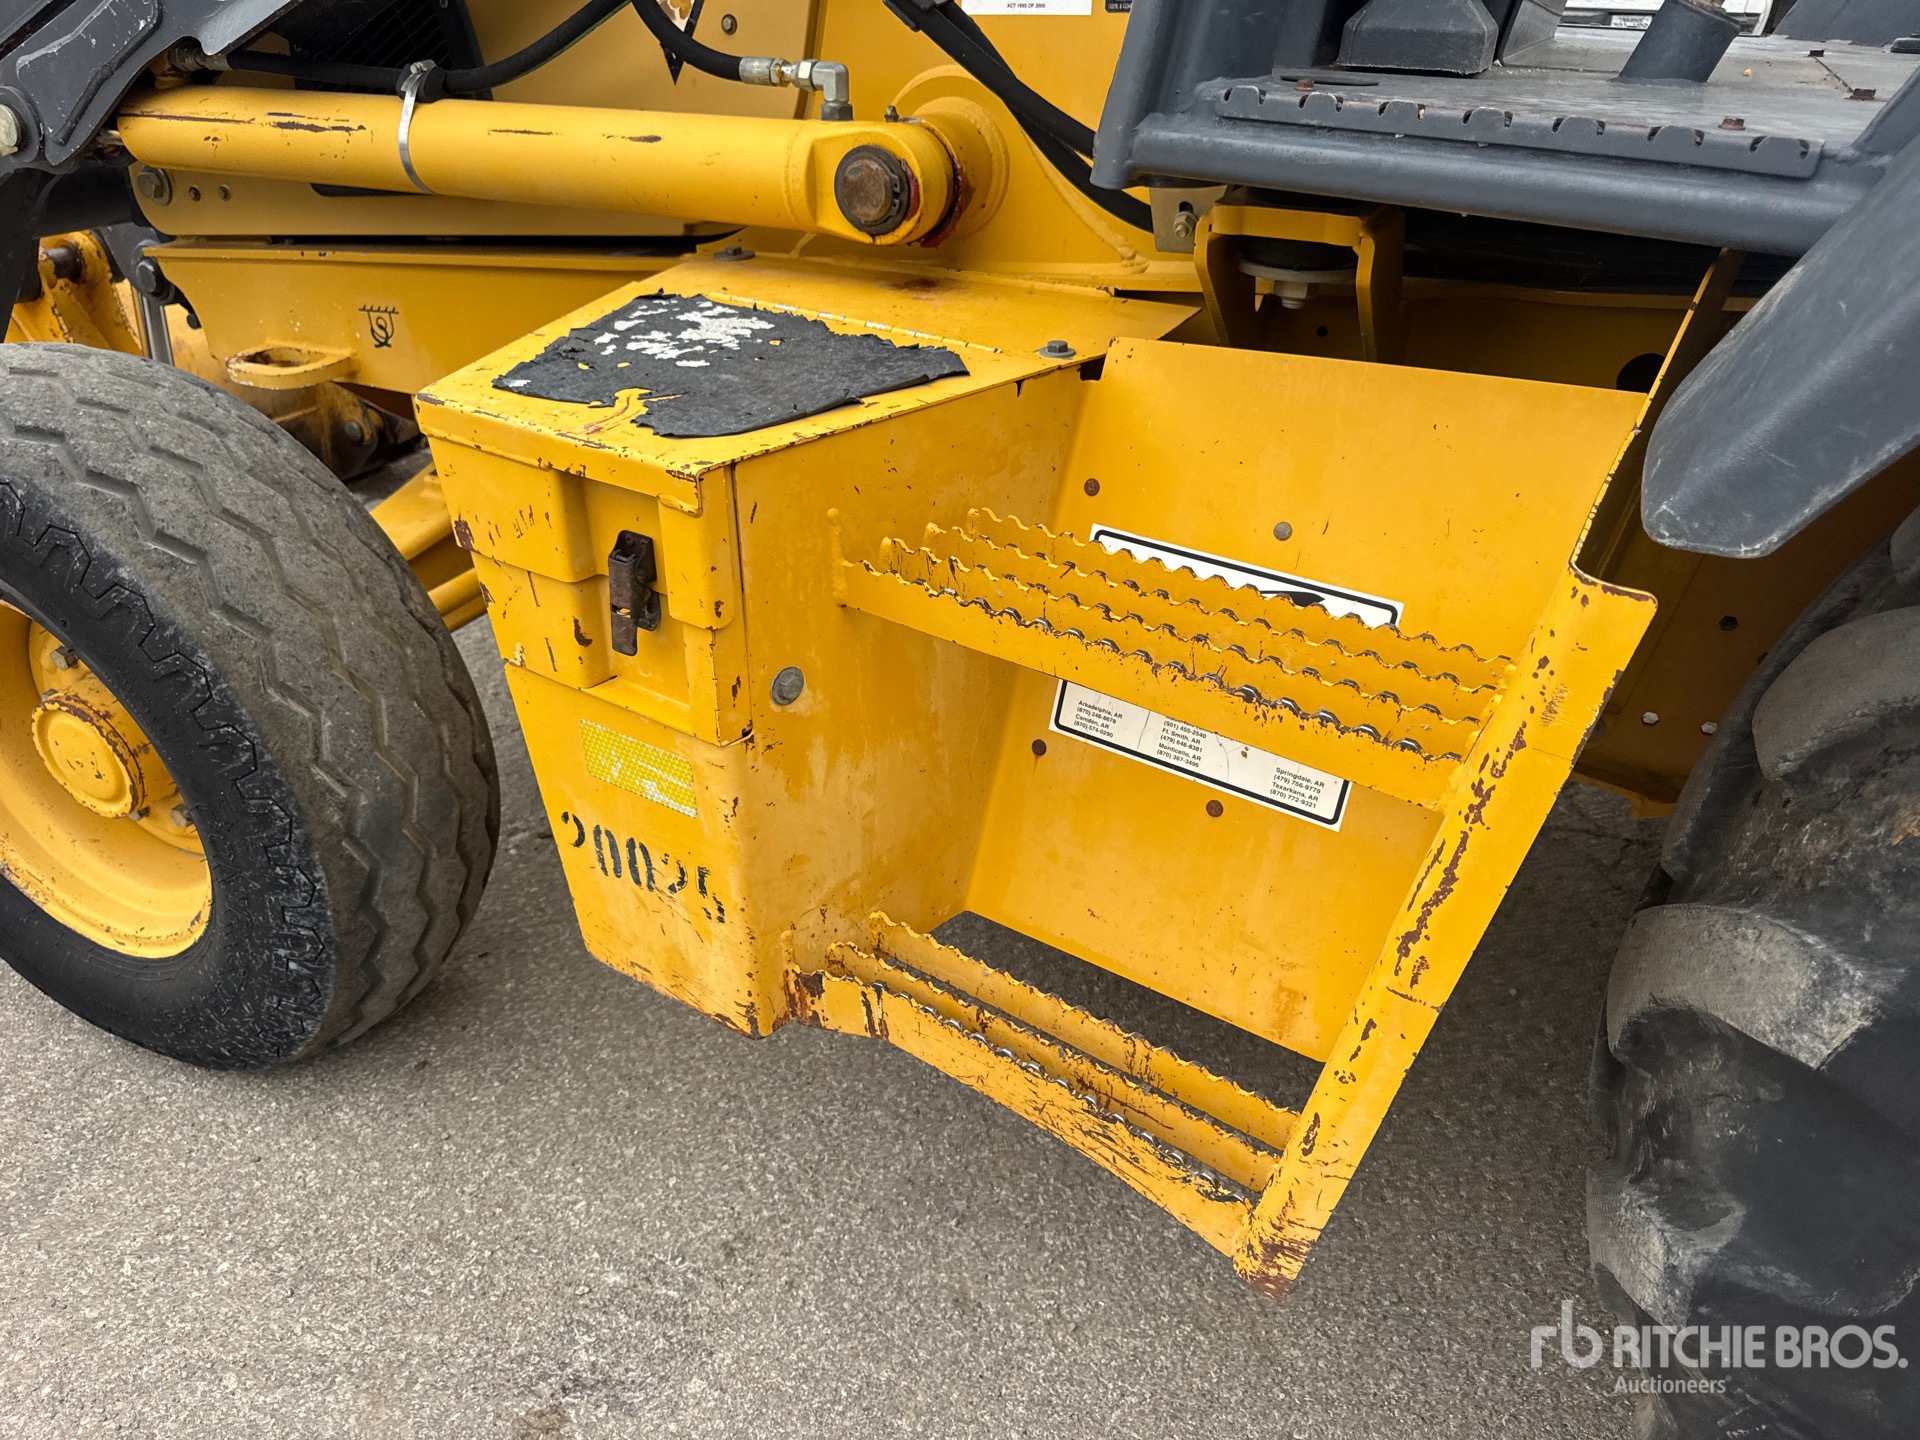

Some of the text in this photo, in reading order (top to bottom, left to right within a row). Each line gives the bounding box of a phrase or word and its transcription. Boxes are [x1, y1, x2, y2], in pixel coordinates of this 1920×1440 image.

[1076, 706, 1091, 716] (870)
[1075, 714, 1099, 727] Camden,
[1163, 720, 1179, 730] (501)
[1160, 734, 1176, 745] (479)
[1170, 730, 1190, 742] Smith,
[1191, 737, 1201, 745] AR
[1156, 749, 1172, 760] (870)
[1158, 742, 1191, 758] Monticello,
[1276, 767, 1312, 785] Springdale,
[1272, 781, 1319, 802] Texarkana, AR
[1273, 774, 1321, 794] (479) 756-9779
[1270, 789, 1316, 808] (870) 772-9321
